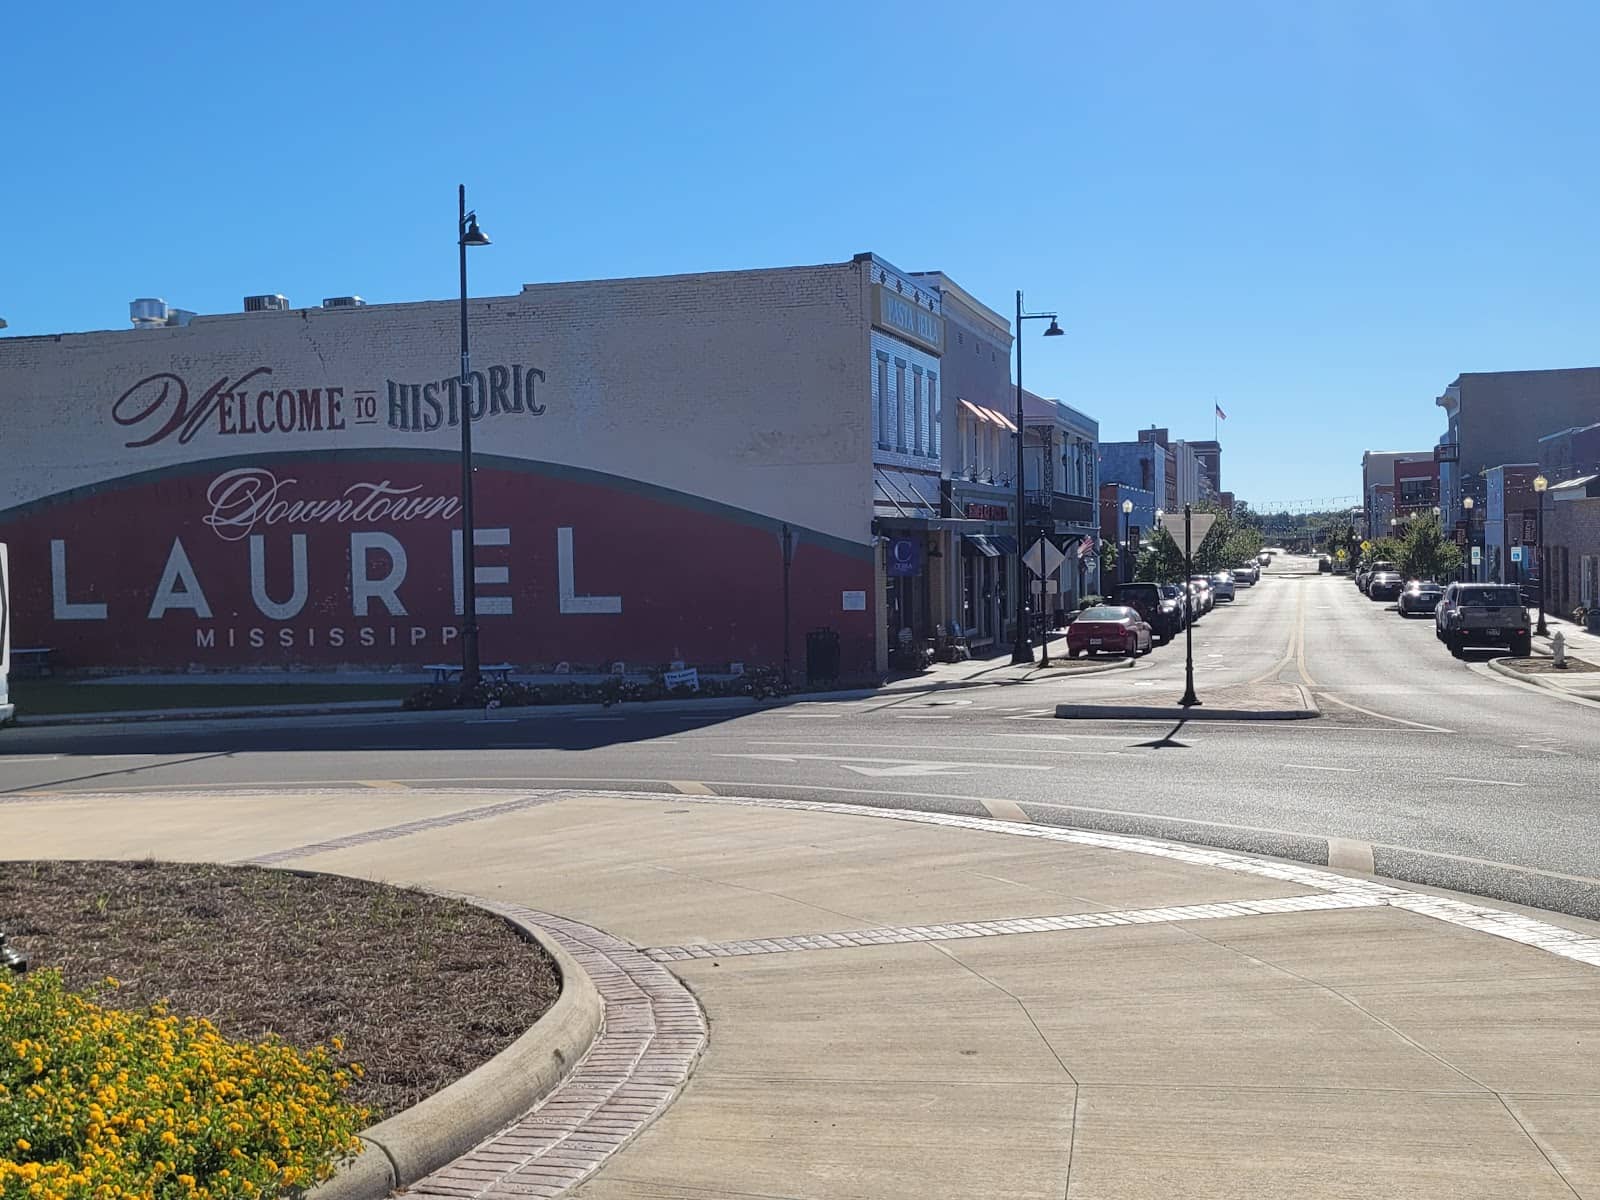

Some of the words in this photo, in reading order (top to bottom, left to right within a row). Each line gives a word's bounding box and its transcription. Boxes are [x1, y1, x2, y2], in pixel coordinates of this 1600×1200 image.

[112, 366, 346, 448] WELCOME
[354, 395, 377, 419] TO
[386, 364, 547, 432] HISTORIC
[202, 467, 464, 541] Downtown
[50, 527, 623, 620] LAUREL
[196, 626, 460, 649] MISSISSIPP
